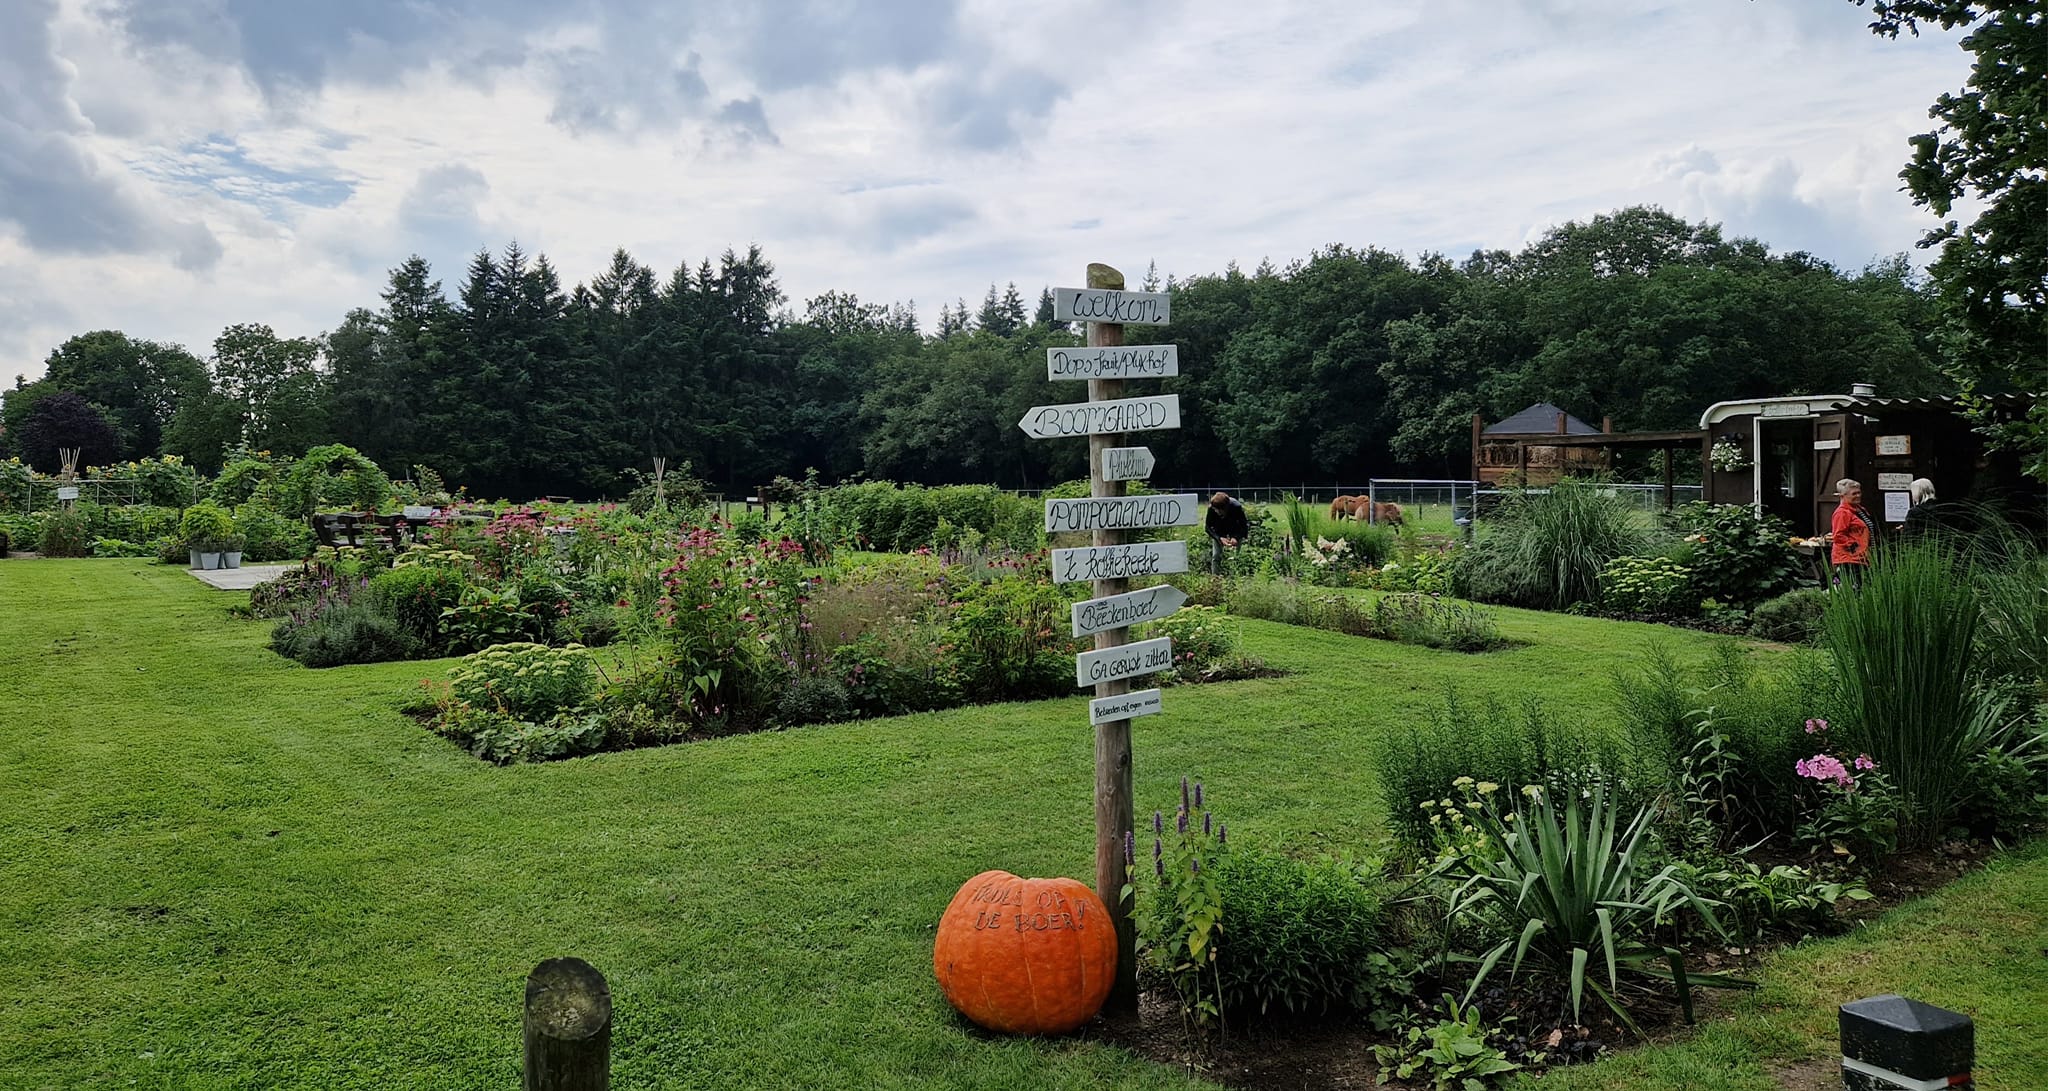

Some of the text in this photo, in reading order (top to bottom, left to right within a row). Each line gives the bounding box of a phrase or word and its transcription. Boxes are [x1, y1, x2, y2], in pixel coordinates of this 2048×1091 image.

[1053, 351, 1093, 377] Dops
[1033, 402, 1167, 437] BOOMGAARD
[1036, 890, 1065, 911] OP
[974, 911, 1001, 931] DE
